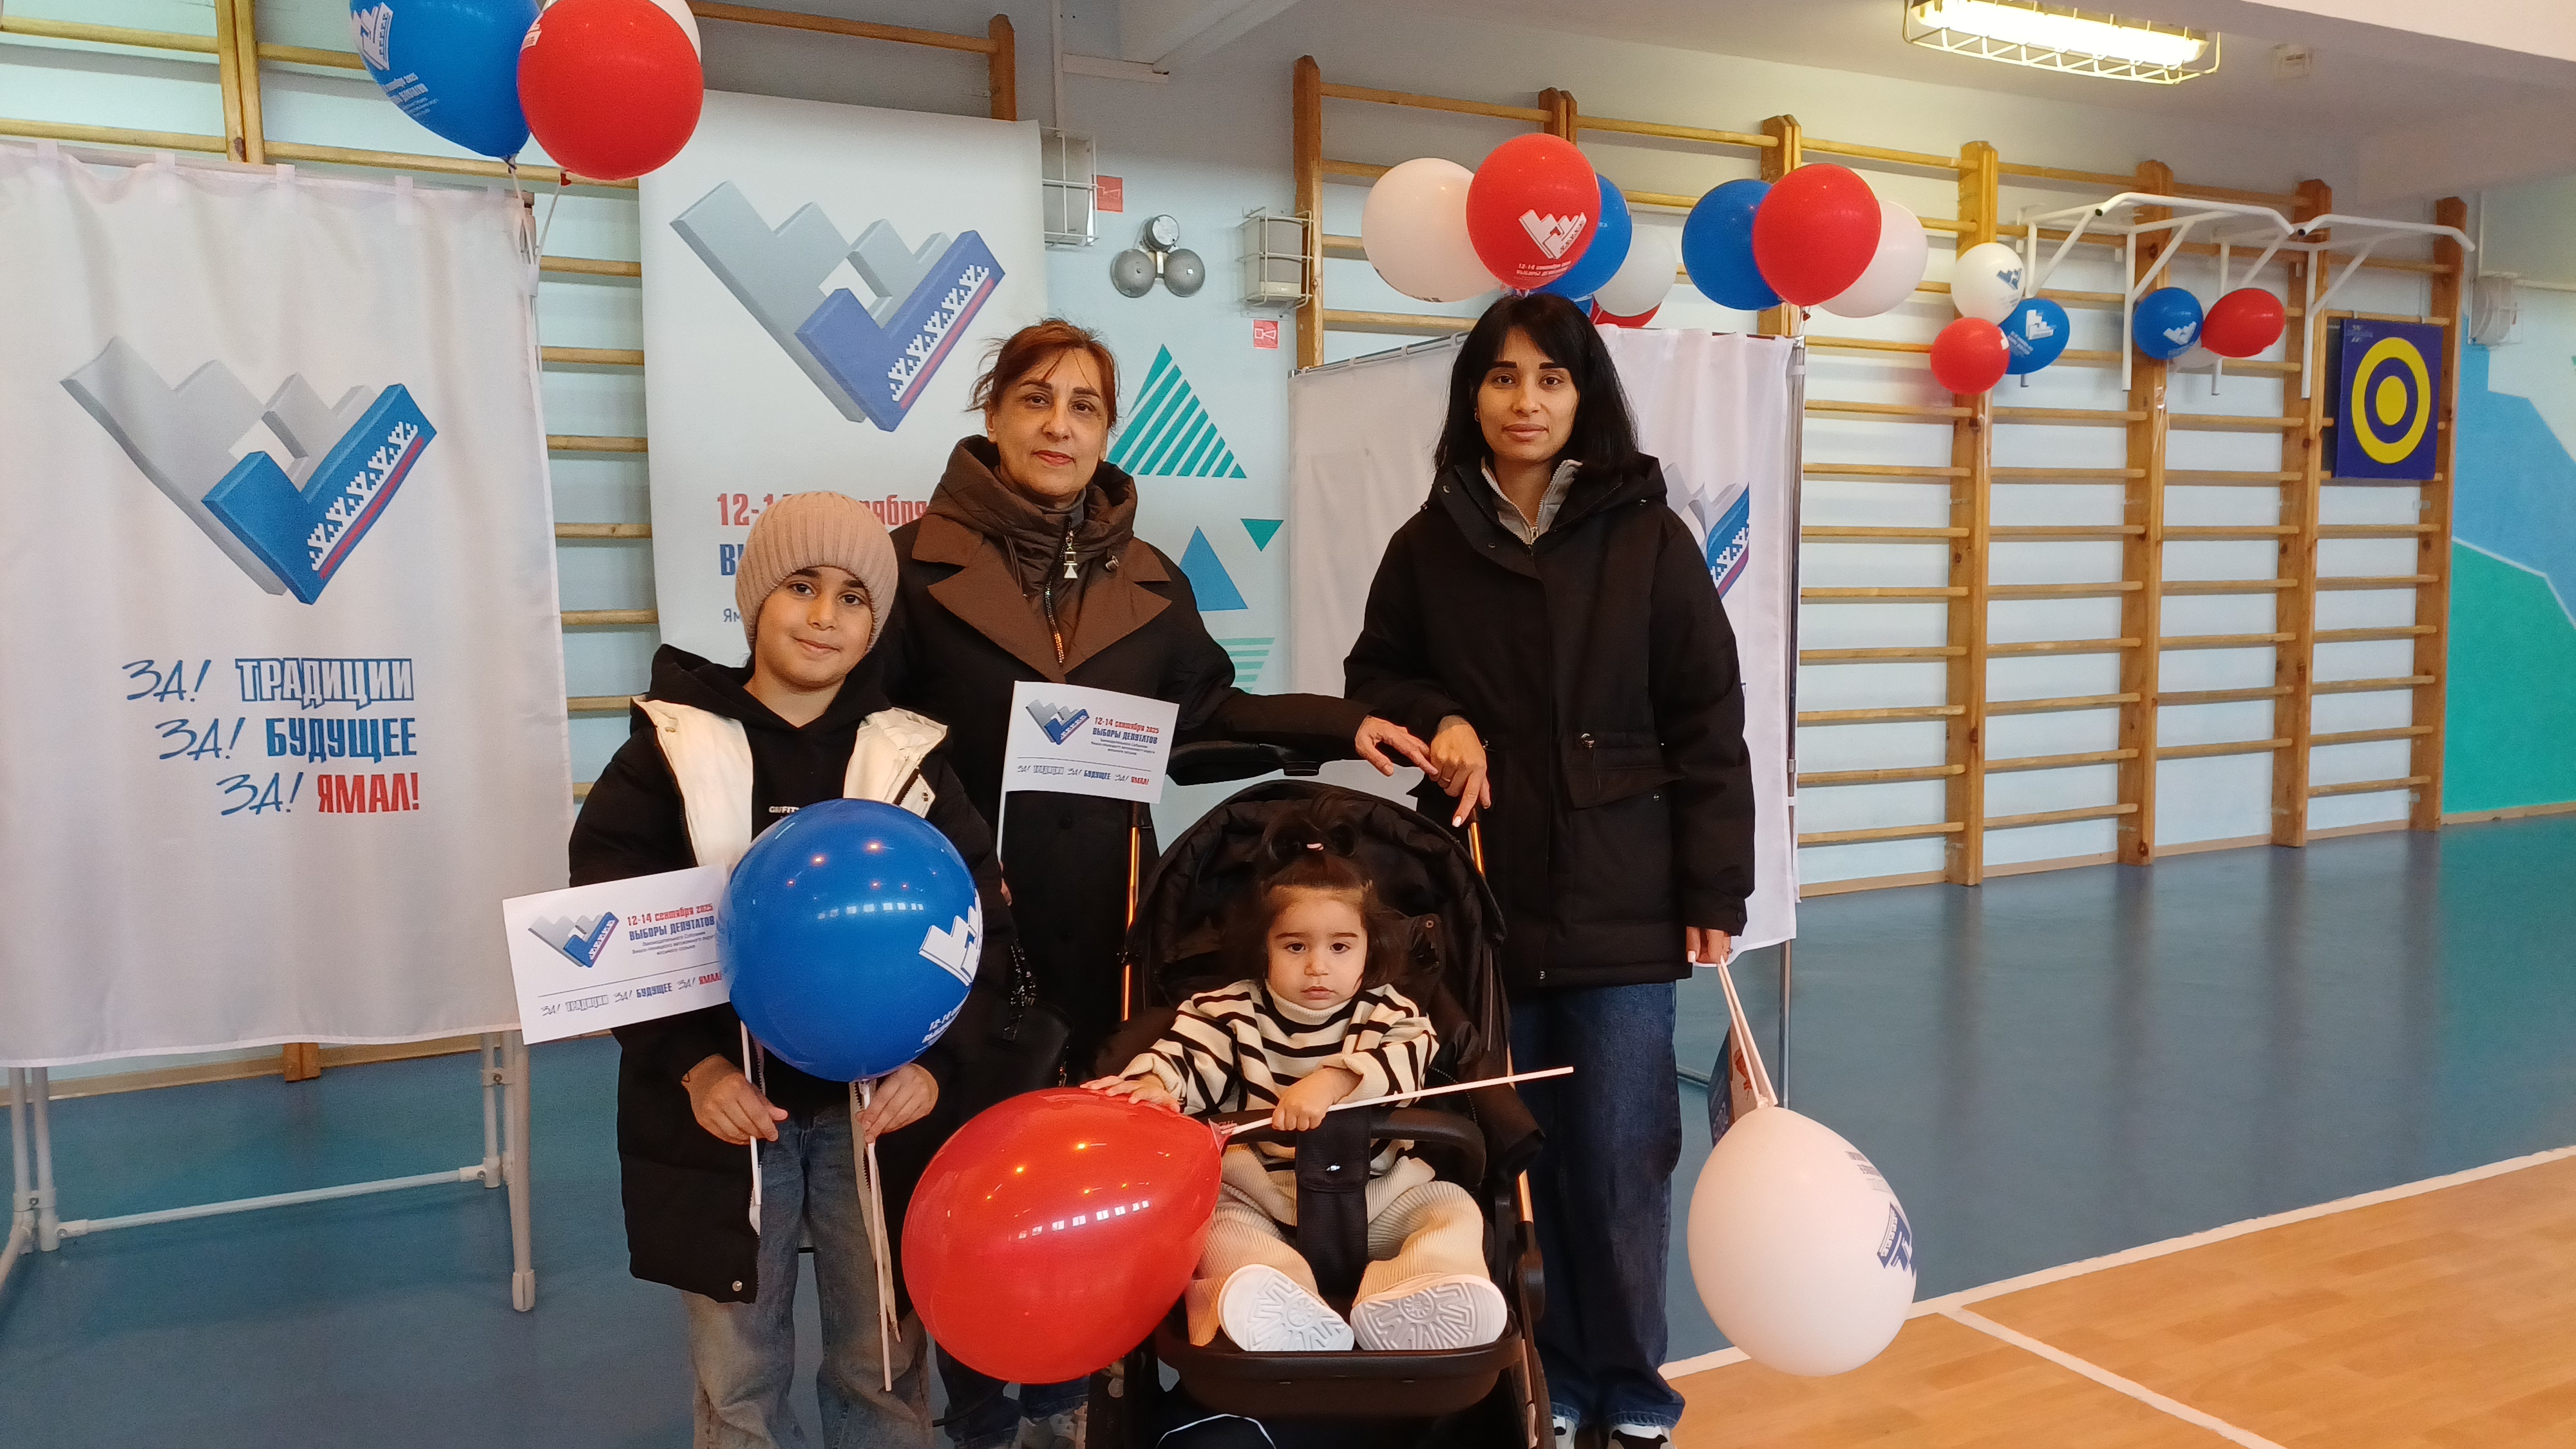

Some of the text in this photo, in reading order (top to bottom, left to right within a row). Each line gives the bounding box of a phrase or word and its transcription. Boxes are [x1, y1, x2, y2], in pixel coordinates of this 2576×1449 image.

[122, 658, 414, 710] ЗА! ТРАДИЦИИ
[1095, 717, 1113, 726] 12-14
[156, 717, 417, 763] ЗА! БУДУЩЕЕ
[1092, 727, 1121, 739] ВЫБОРЫ
[1122, 732, 1158, 744] ДЕПУТАТОВ
[1084, 770, 1111, 780] БУДУЩЕЕ
[217, 772, 419, 815] ЗА! ЯМАЛ!
[627, 913, 652, 926] 12-14
[629, 925, 667, 941] ВЫБОРЫ
[670, 915, 715, 934] ДЕПУТАТОВ
[541, 1004, 560, 1016] ЗА!
[613, 990, 632, 1003] ЗА!
[636, 983, 672, 998] БУДУЩЕЕ
[677, 978, 696, 990] ЗА!
[698, 972, 722, 985] ЯМАЛ!
